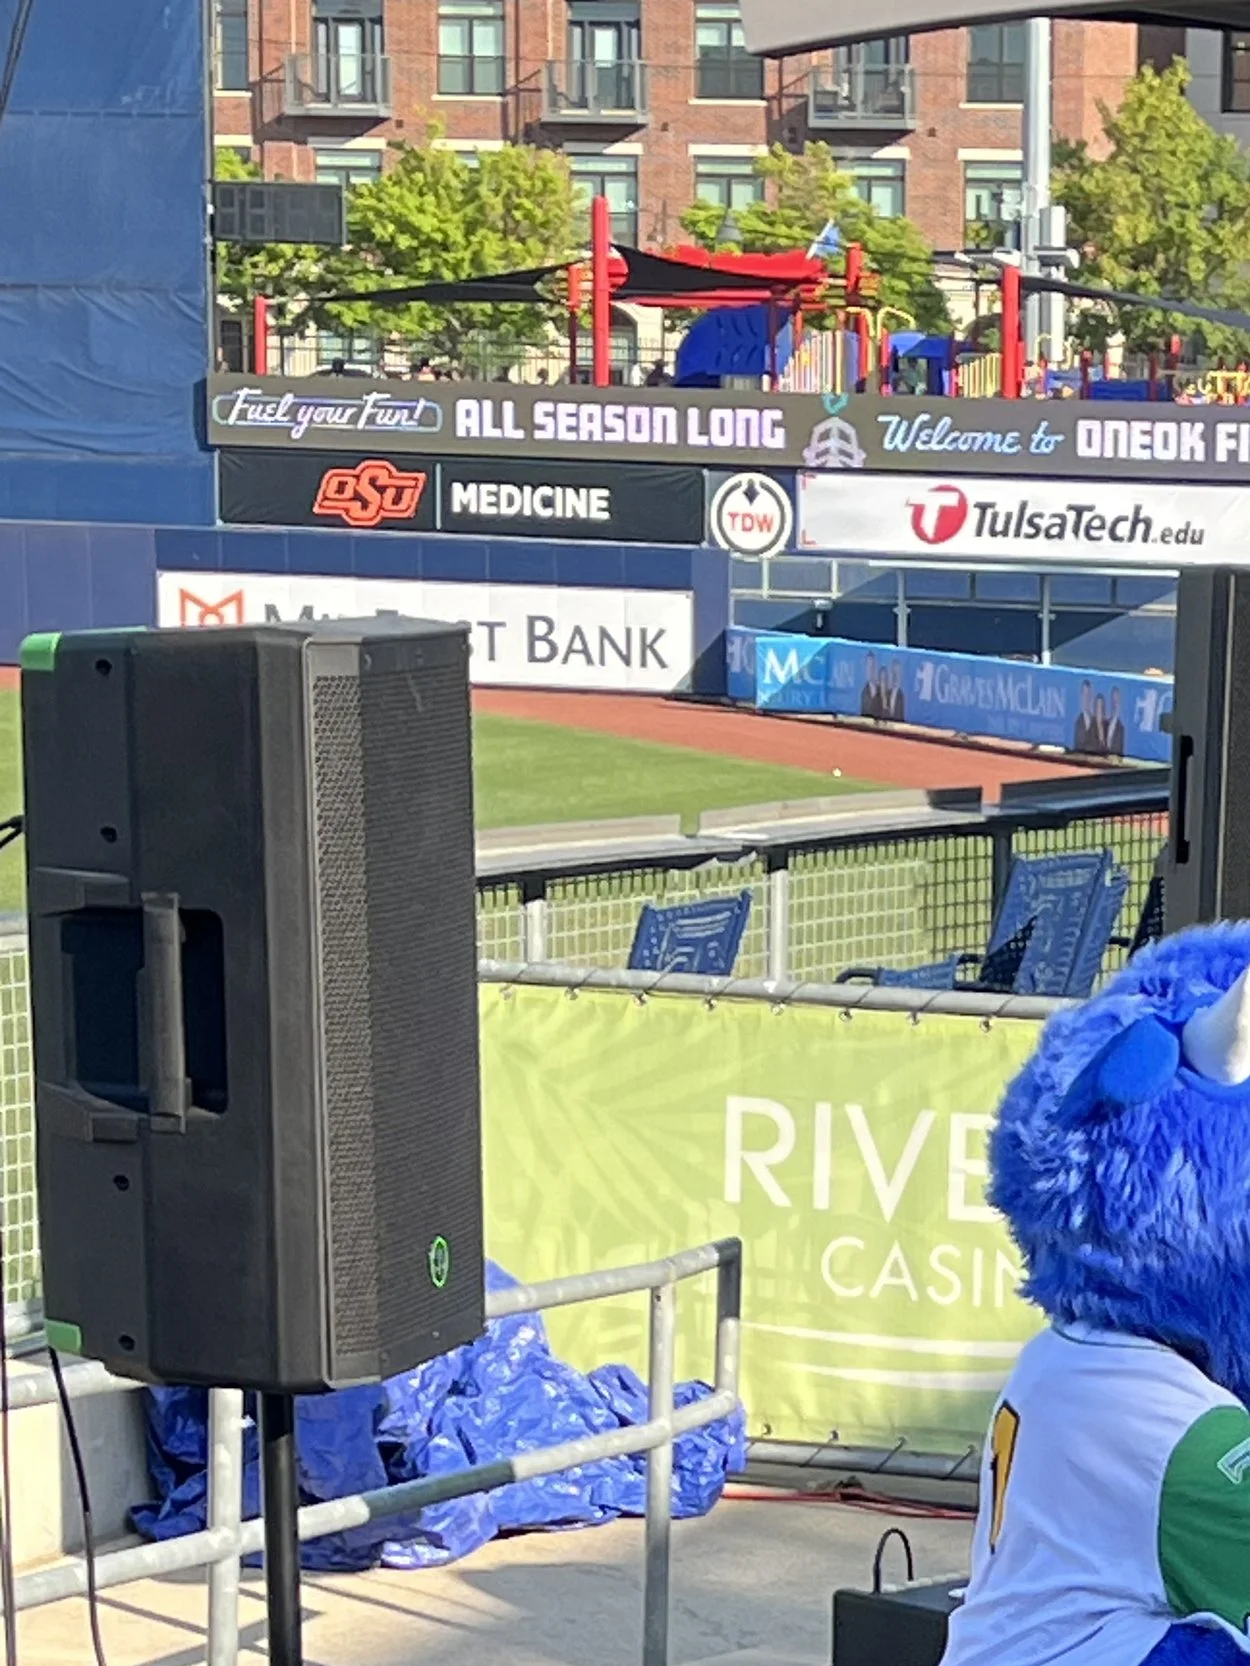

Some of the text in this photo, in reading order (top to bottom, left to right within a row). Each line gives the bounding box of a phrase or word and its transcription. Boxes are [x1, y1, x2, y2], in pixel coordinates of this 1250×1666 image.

[228, 387, 427, 440] Fuel your Fun!
[455, 398, 786, 449] ALL SEASON LONG
[876, 413, 1022, 454] Welcome
[1029, 421, 1065, 455] to
[1075, 418, 1206, 462] ONEOK
[313, 458, 428, 528] OSU
[451, 481, 611, 521] MEDICINE
[727, 510, 775, 534] TDW
[973, 499, 1205, 546] TulsaTech.edu
[723, 1095, 1006, 1225] RIVE
